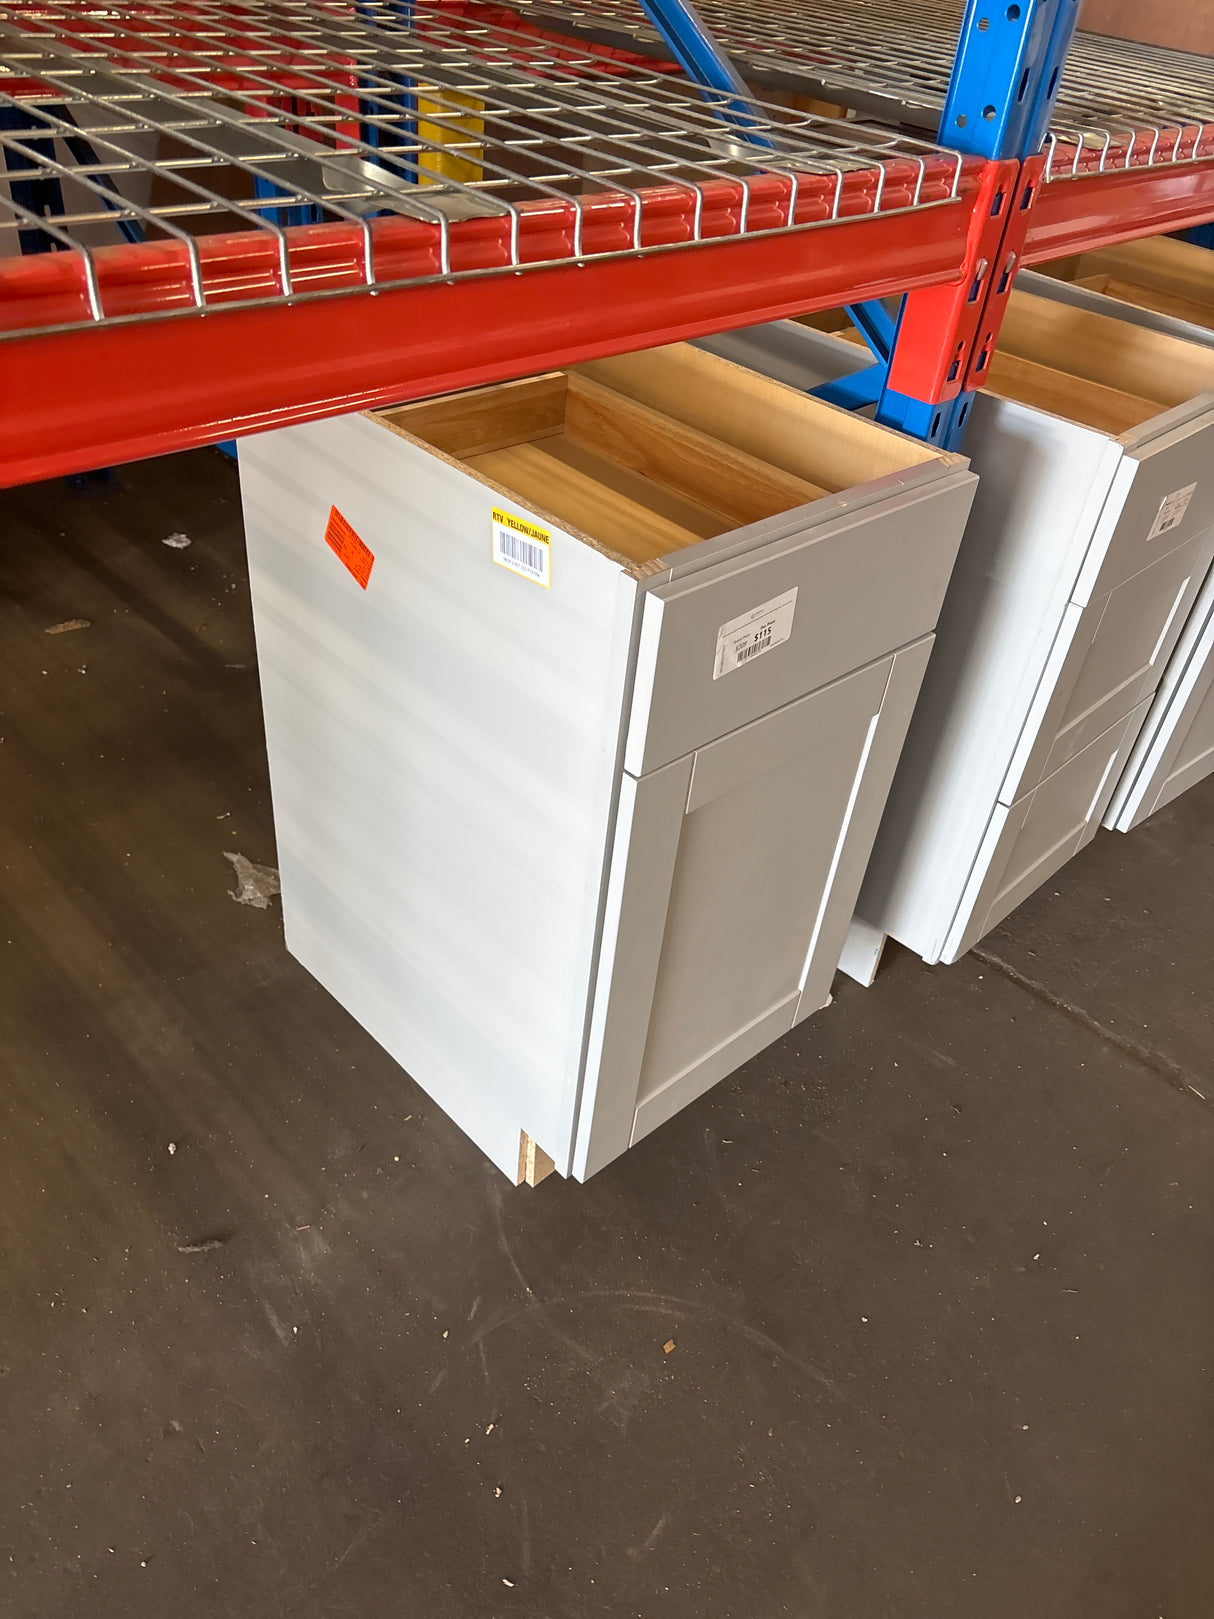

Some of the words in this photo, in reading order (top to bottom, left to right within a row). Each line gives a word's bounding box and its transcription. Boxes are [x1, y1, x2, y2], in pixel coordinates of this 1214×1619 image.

[493, 511, 503, 523] RTV
[507, 517, 549, 544] YELLOW/JAUNE
[754, 626, 772, 642] $115
